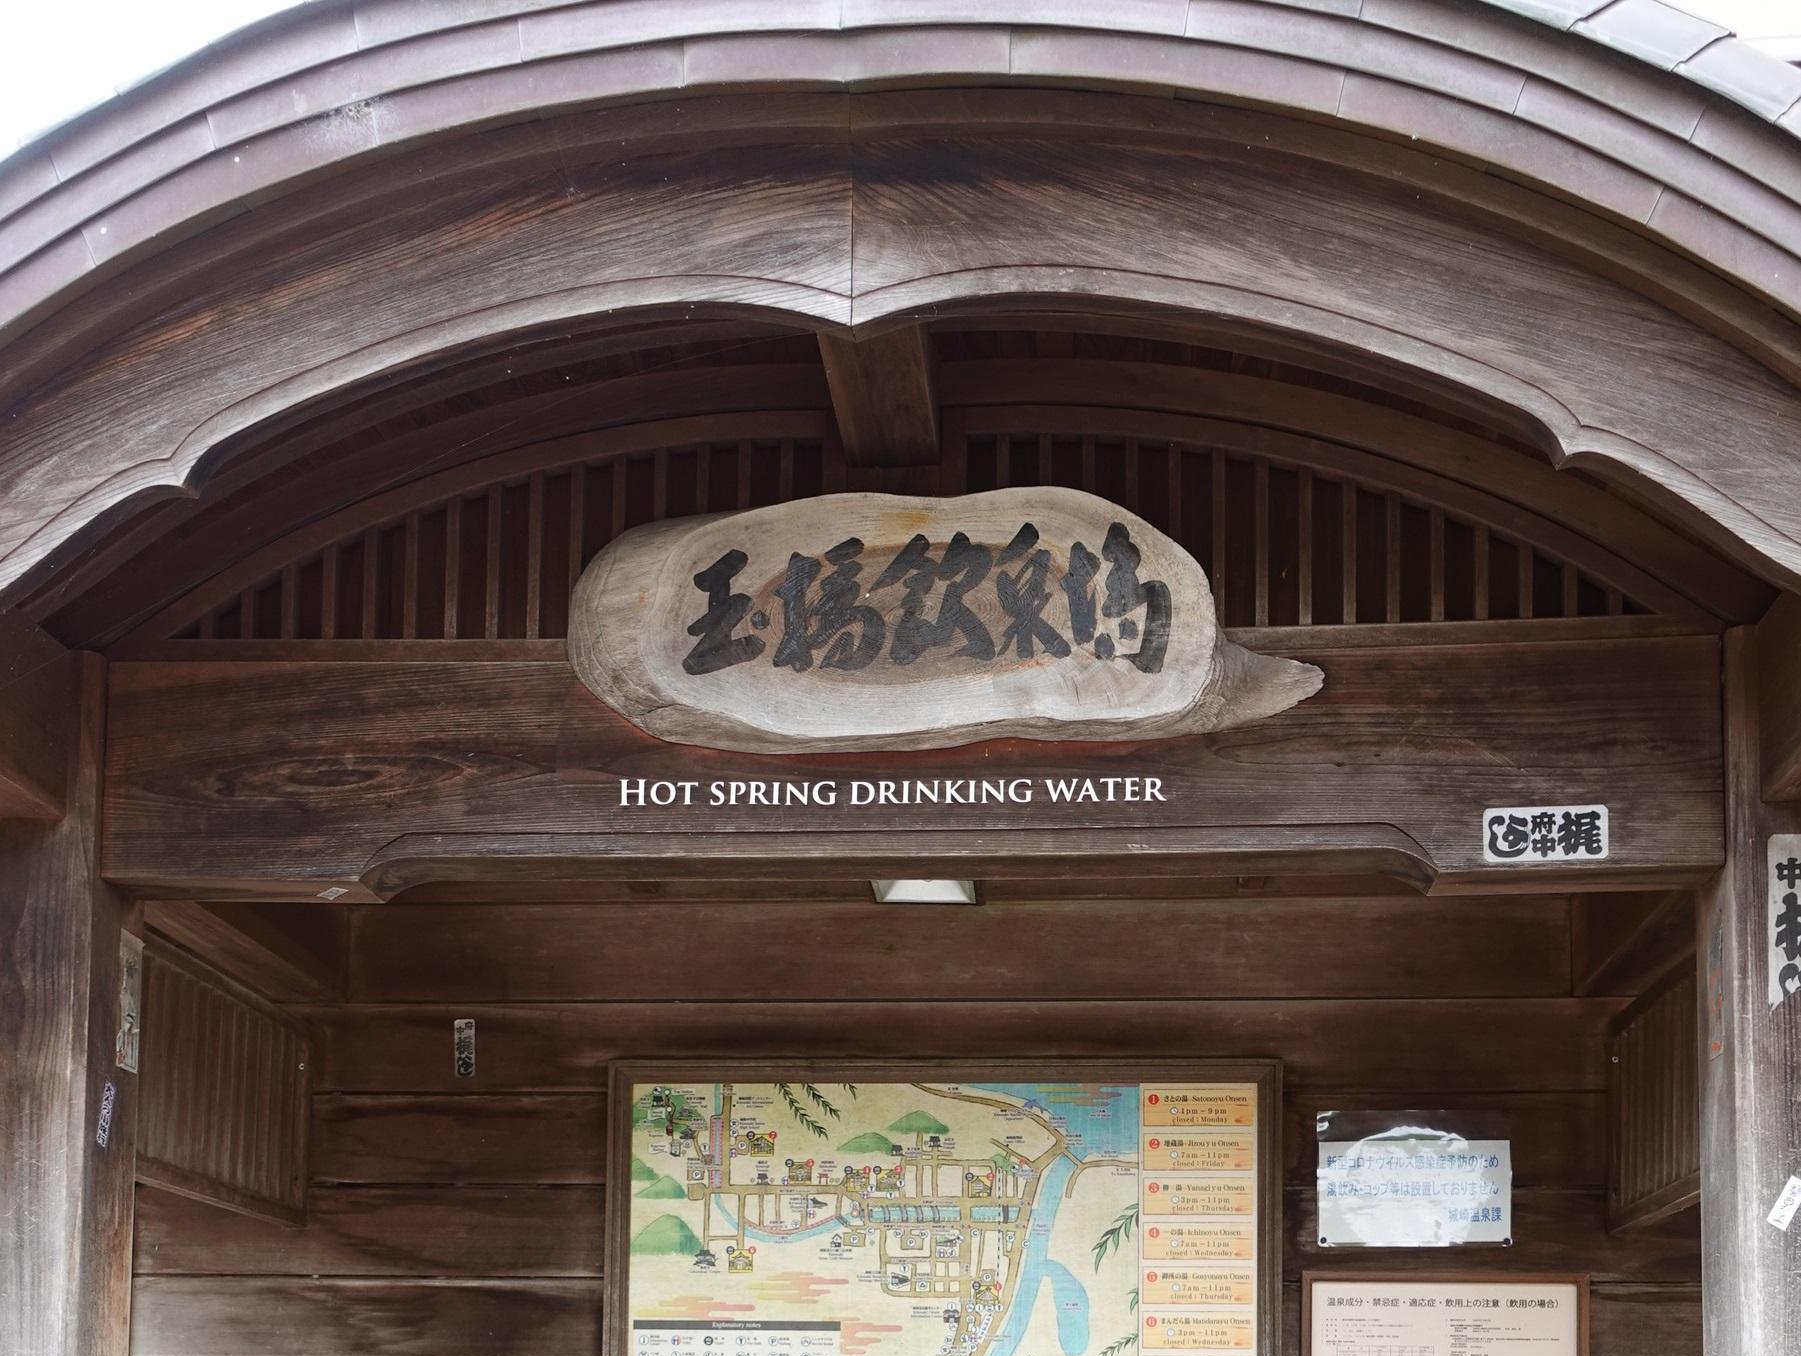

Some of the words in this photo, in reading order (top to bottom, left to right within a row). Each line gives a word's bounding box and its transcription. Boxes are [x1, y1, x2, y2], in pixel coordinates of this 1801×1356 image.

[619, 779, 700, 807] HOT
[709, 781, 837, 806] SPRING
[849, 779, 1033, 804] DRINKING
[1044, 777, 1167, 803] WATER
